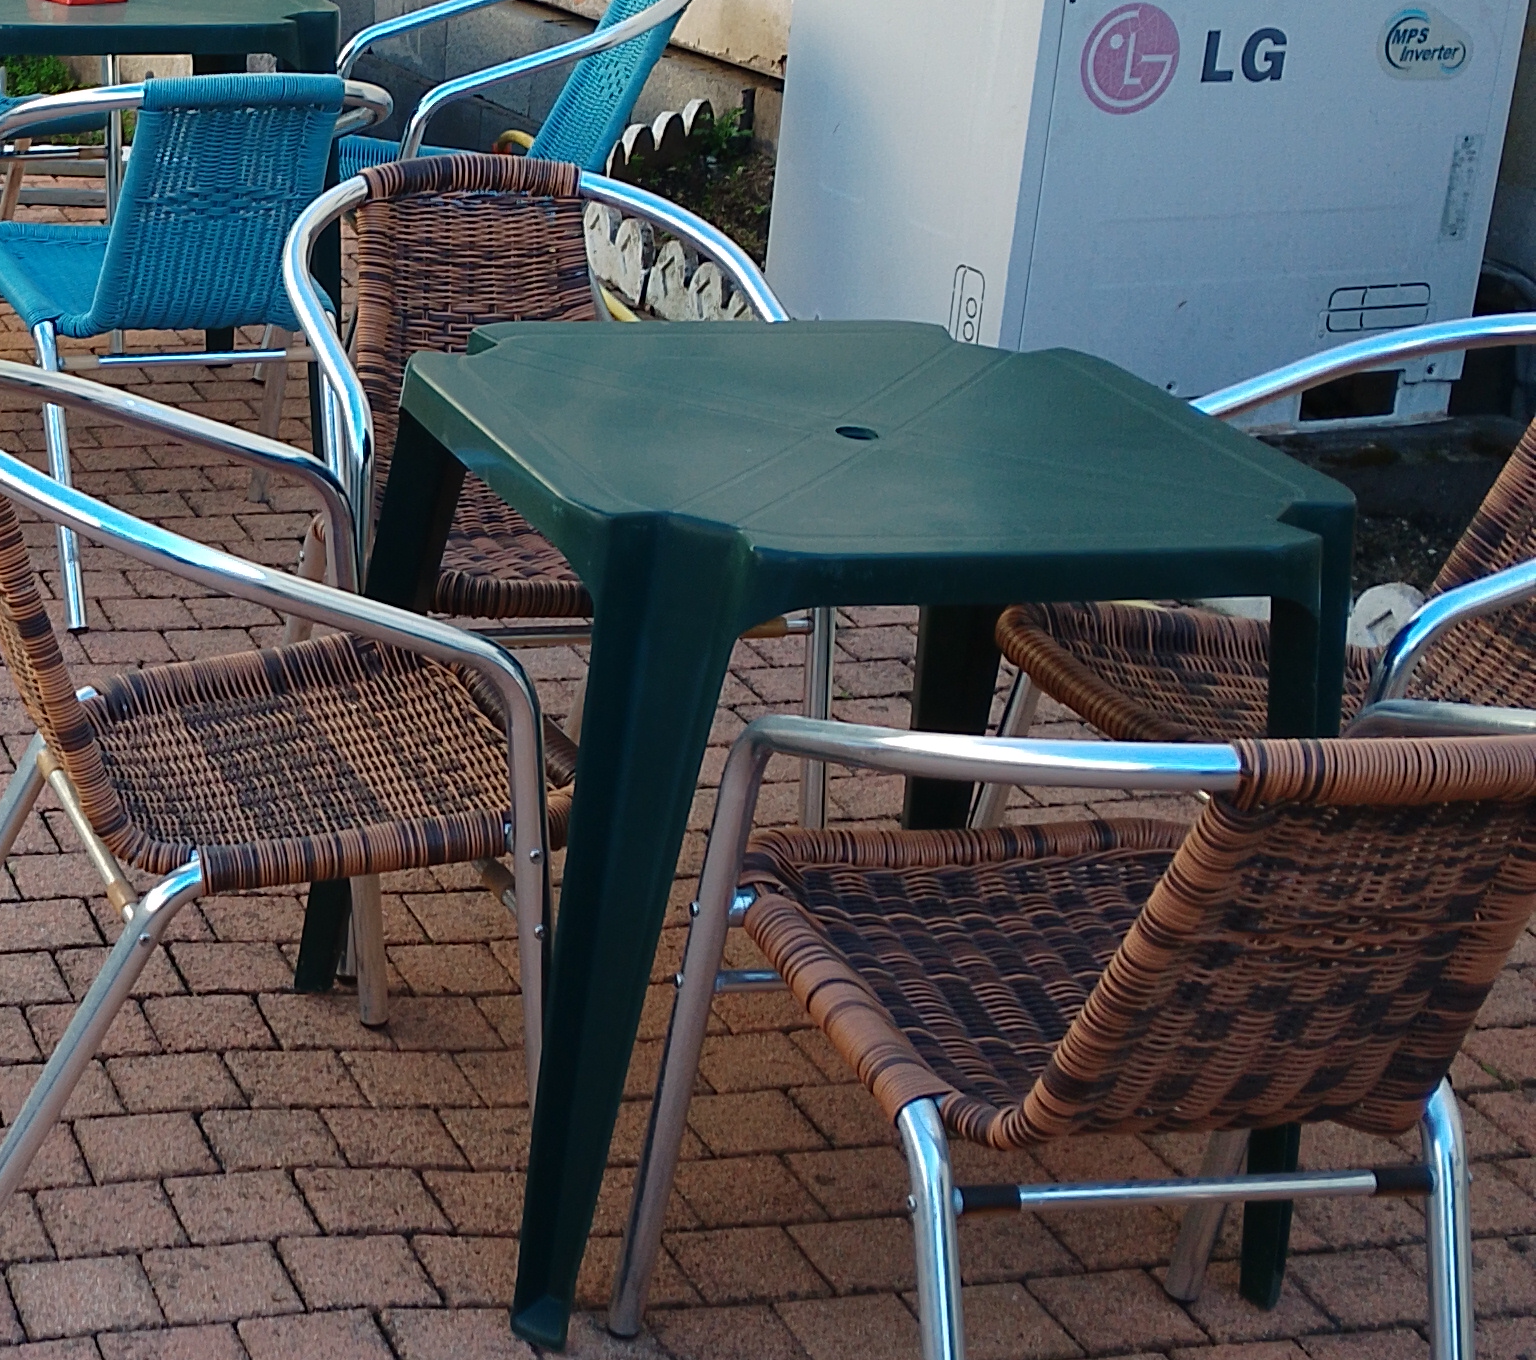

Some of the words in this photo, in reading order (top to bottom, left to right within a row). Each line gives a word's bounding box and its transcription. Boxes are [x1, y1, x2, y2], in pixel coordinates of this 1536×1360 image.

[1391, 27, 1430, 44] MPS
[1200, 27, 1289, 83] LG
[1399, 44, 1460, 62] Inverter
